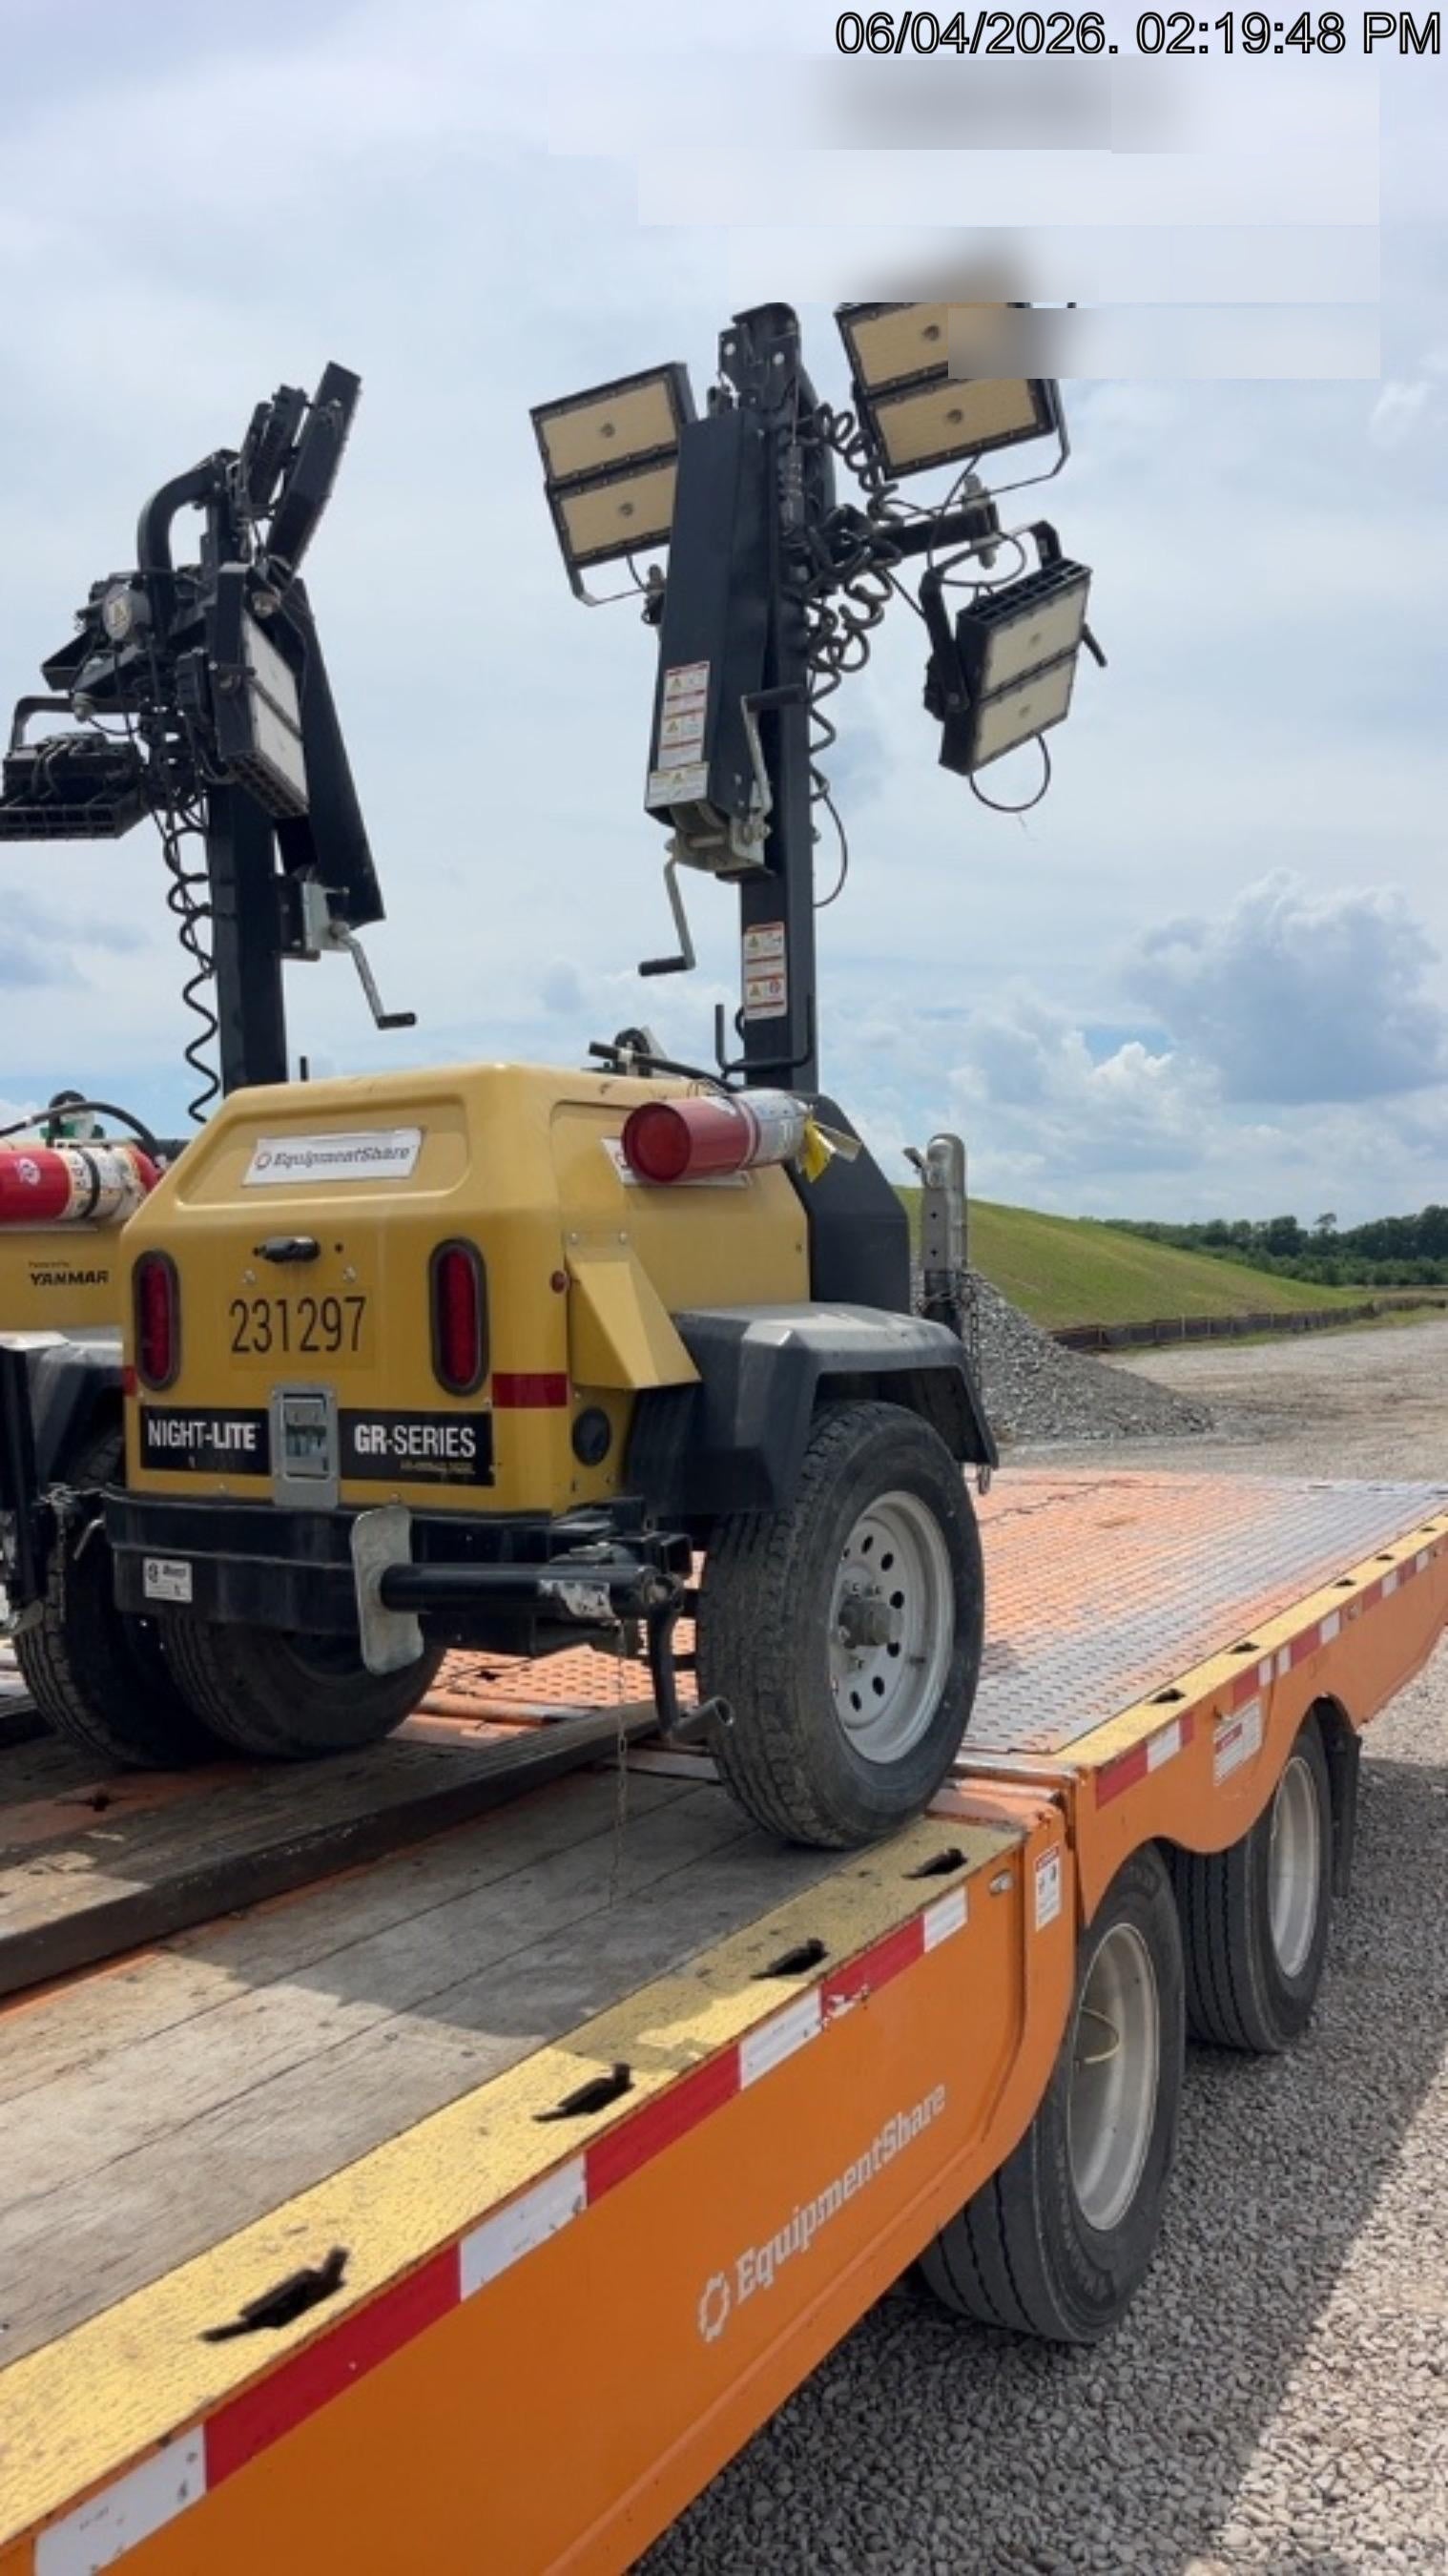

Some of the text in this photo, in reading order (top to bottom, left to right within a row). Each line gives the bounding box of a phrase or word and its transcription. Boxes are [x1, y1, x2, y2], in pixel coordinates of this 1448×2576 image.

[273, 1145, 410, 1169] EquipmentShare
[30, 1270, 110, 1286] YANMAR
[228, 1296, 367, 1354] 231297
[148, 1419, 257, 1450] NIGHT-LITE
[354, 1423, 477, 1459] GR-SERIES
[734, 2083, 946, 2306] EquipmentShare
